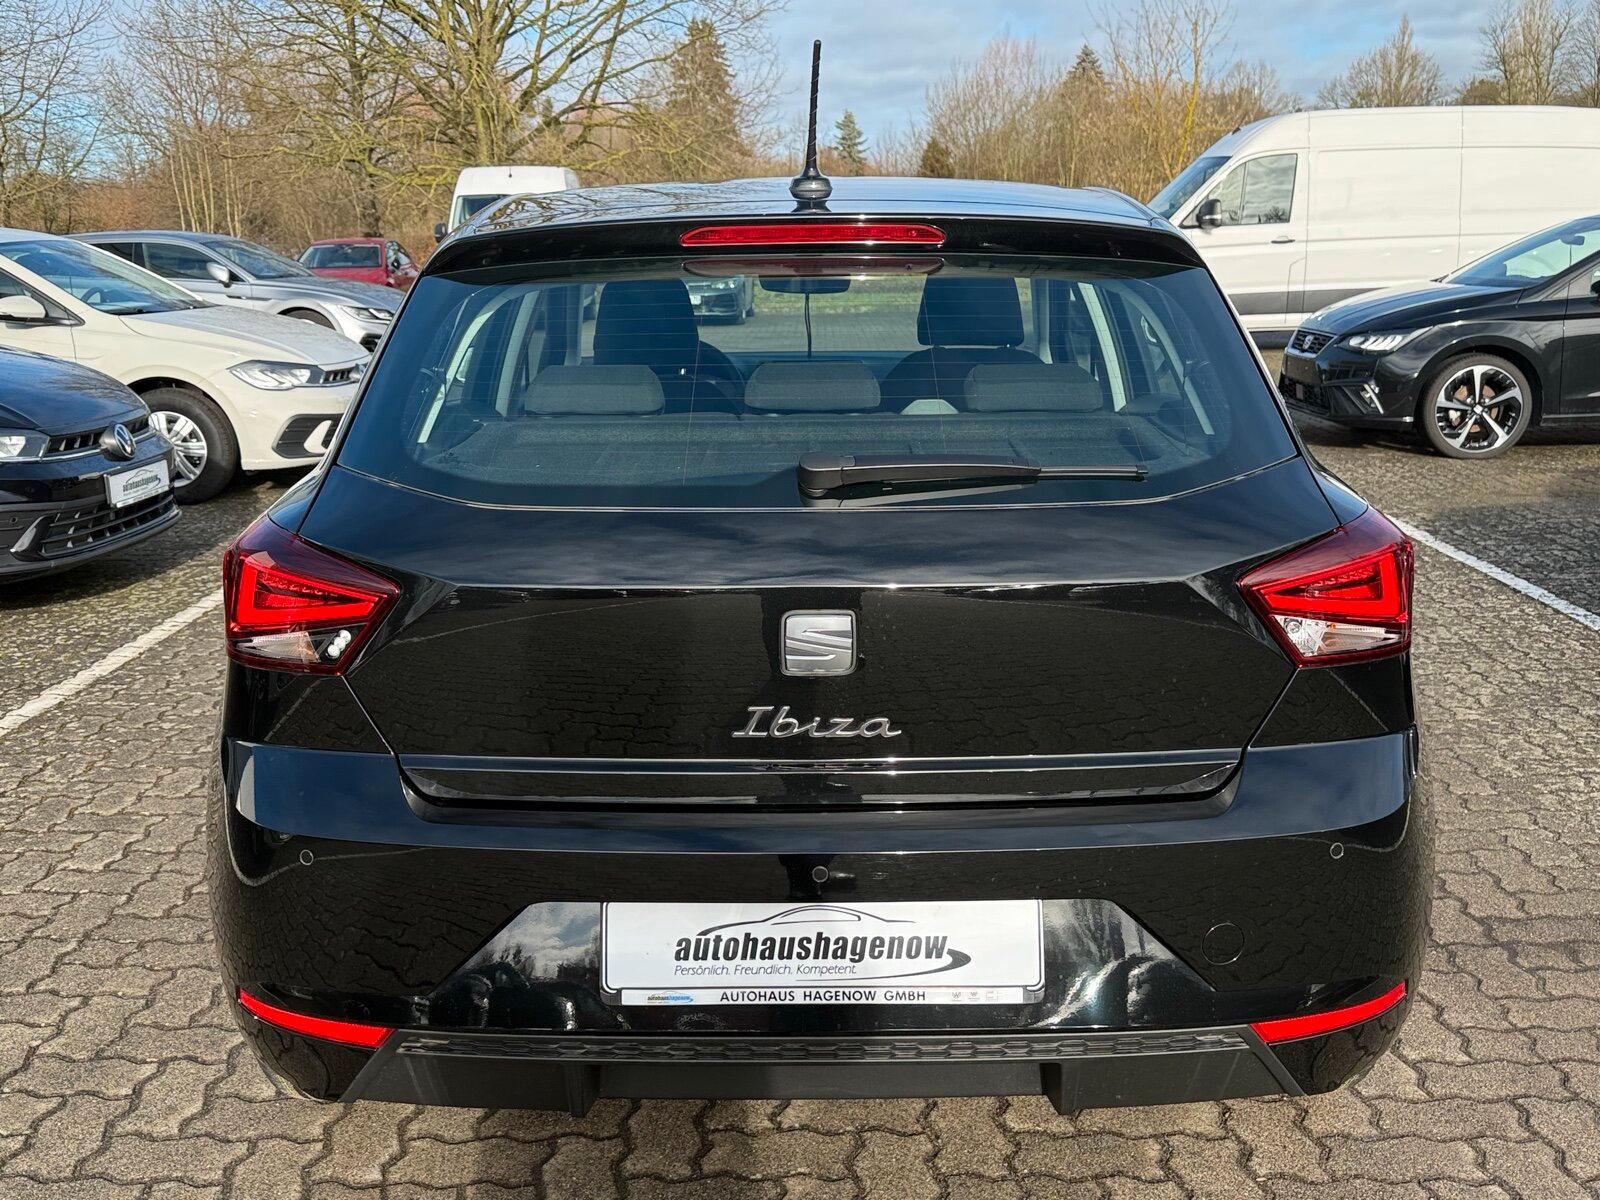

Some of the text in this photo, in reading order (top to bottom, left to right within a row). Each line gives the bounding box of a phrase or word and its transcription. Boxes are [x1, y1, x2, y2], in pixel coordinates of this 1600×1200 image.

[731, 705, 902, 738] Ibiza
[674, 932, 948, 963] autohaushagenow
[674, 964, 731, 976] Persönlich.
[734, 964, 793, 975] Freundlich.
[720, 990, 926, 1002] AUTOHAUS HAGENOW GMBH
